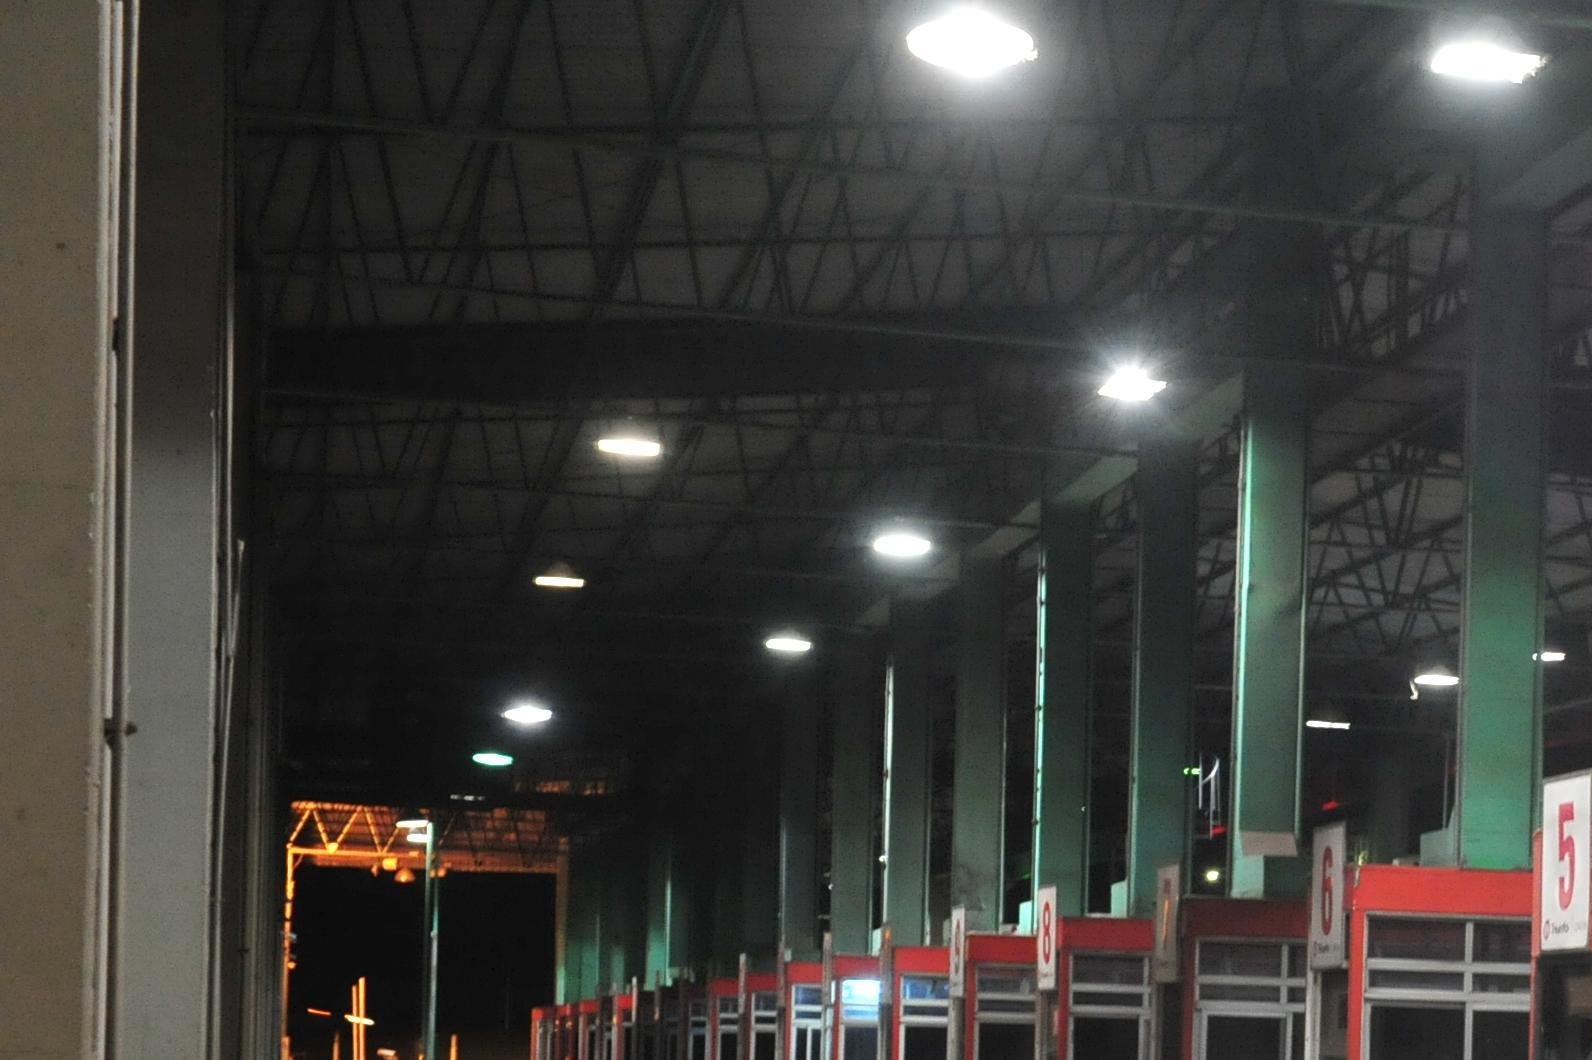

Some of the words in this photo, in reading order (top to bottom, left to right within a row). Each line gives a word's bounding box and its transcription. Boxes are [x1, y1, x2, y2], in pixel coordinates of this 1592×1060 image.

[1322, 847, 1333, 936] 6
[1559, 803, 1575, 910] 5
[1043, 902, 1051, 964] 8
